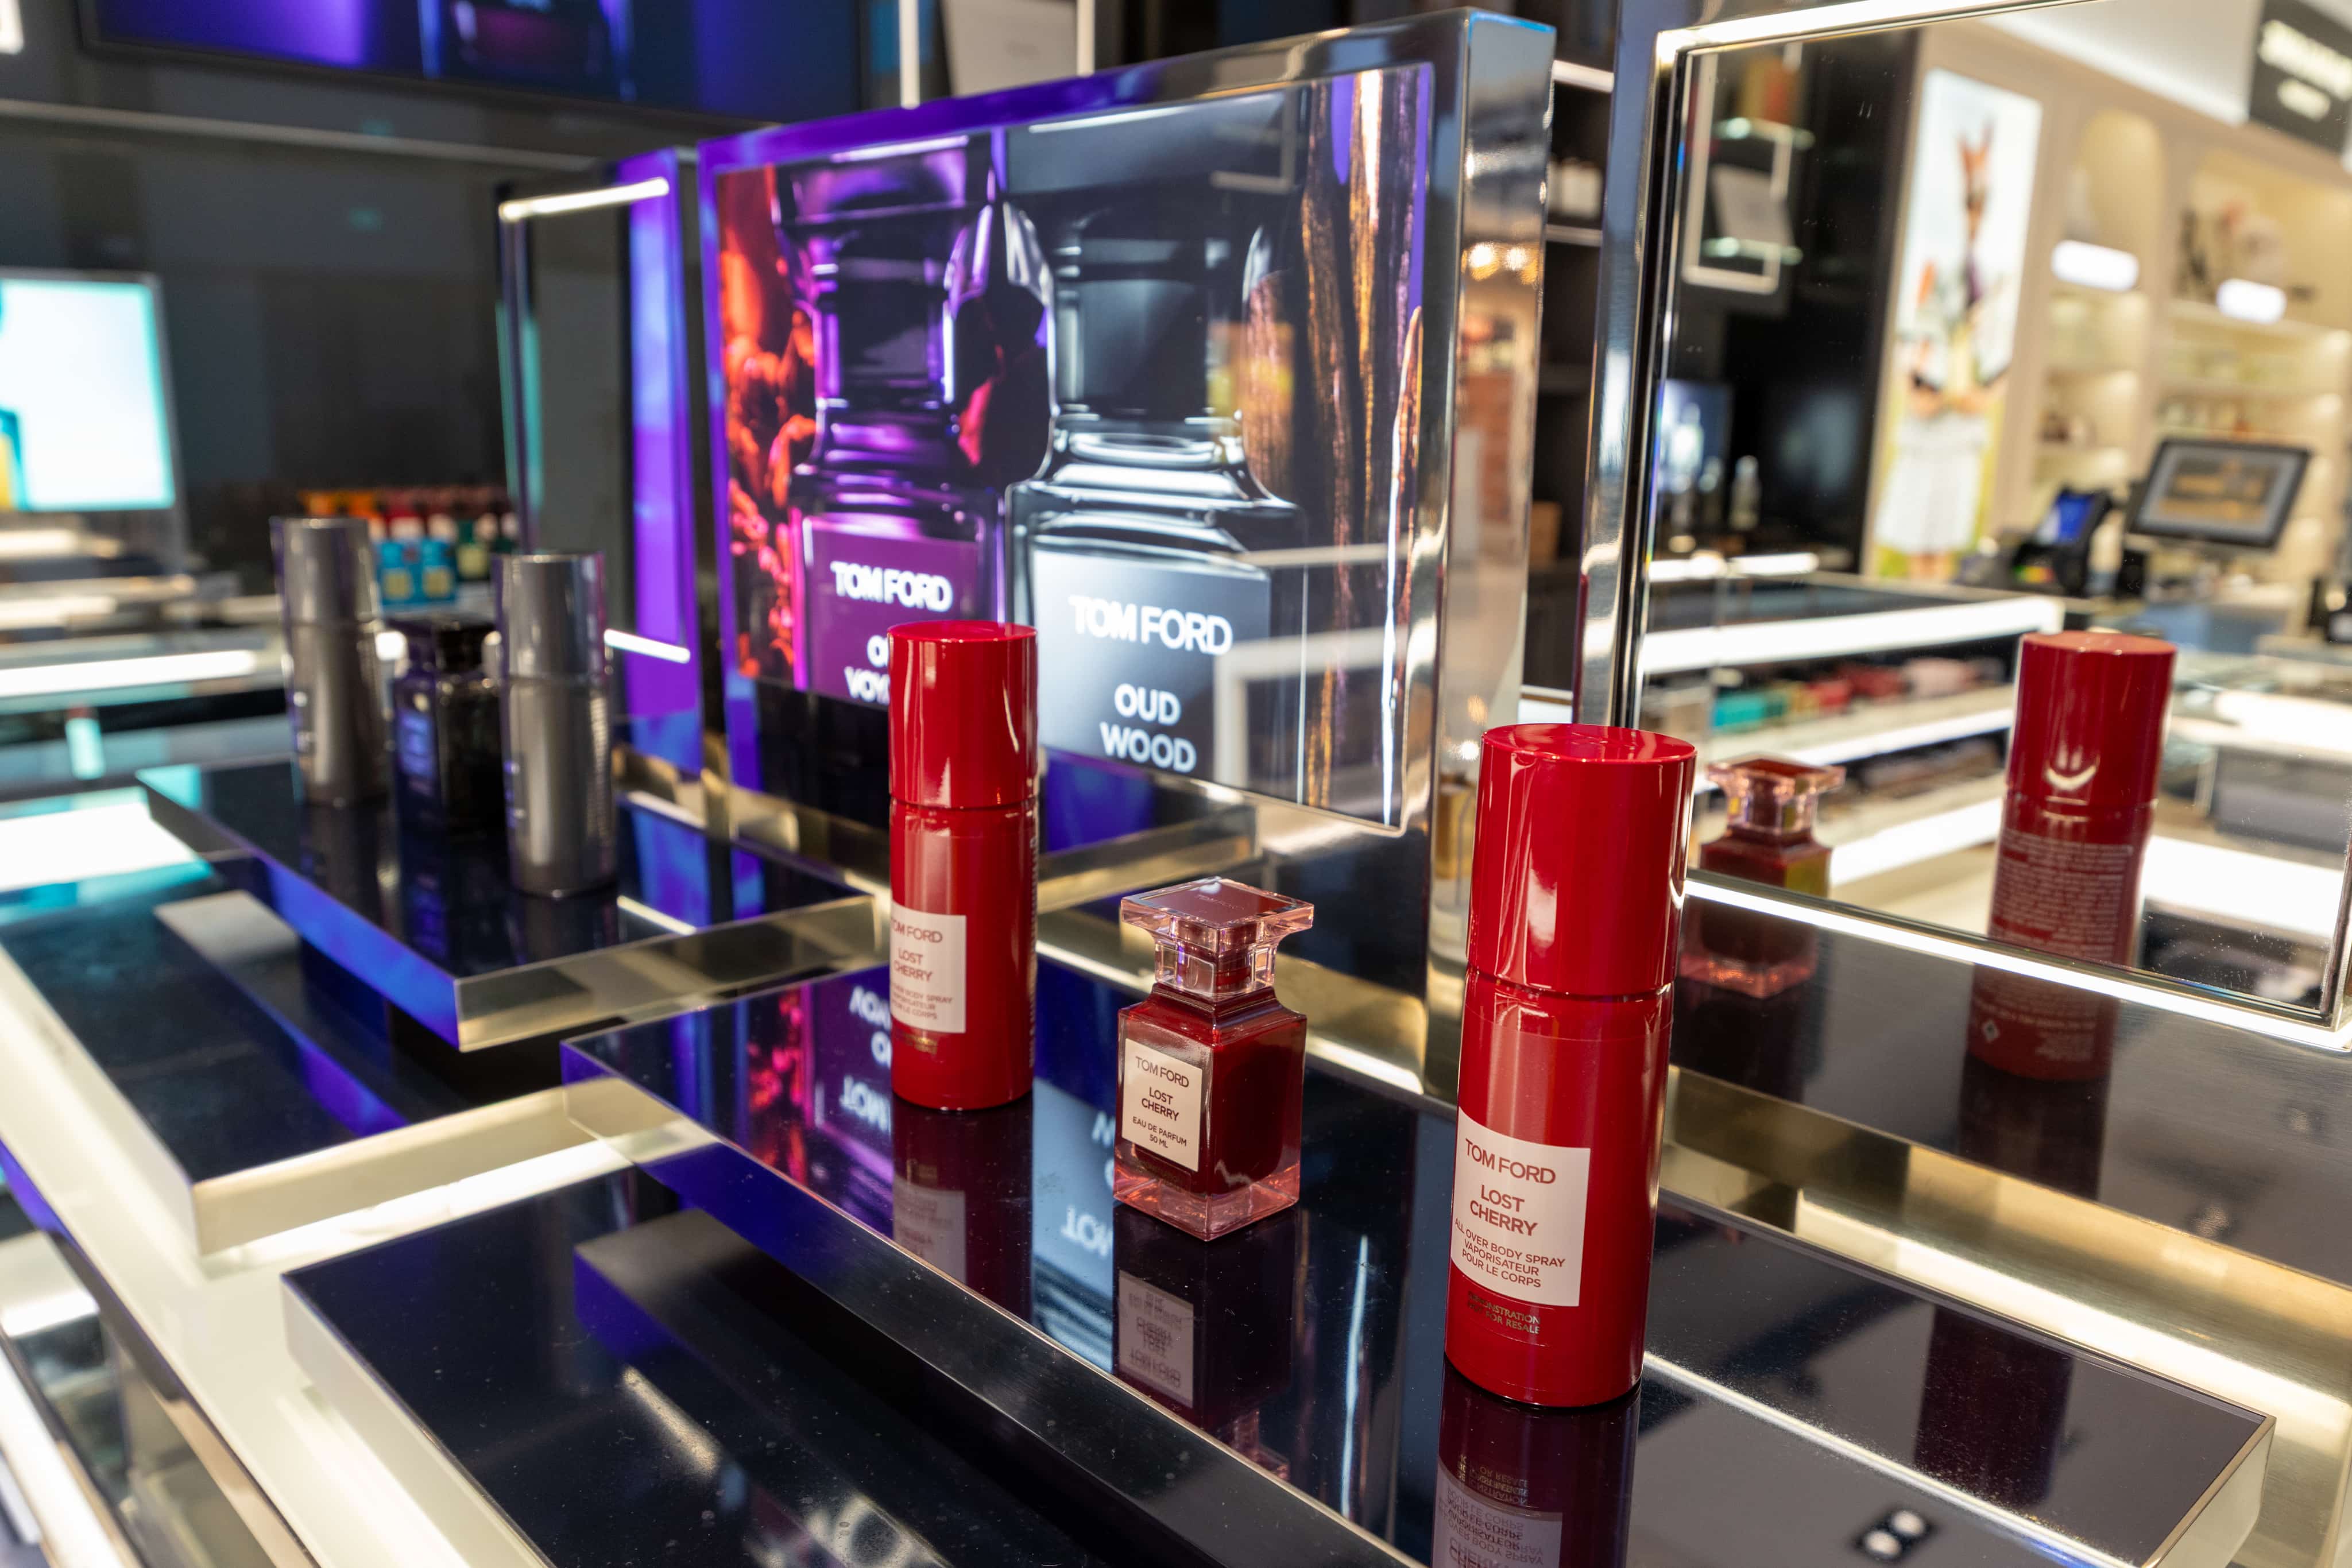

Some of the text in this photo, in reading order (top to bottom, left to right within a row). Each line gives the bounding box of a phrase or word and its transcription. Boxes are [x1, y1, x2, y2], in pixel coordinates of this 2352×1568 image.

[830, 560, 954, 612] TOM FORD
[1069, 595, 1233, 655] TOM FORD
[1114, 683, 1181, 726] OUD
[1100, 722, 1197, 773] WOOD
[907, 925, 943, 943] FORD
[894, 959, 933, 981] CHERRY
[898, 947, 923, 965] LOST
[1135, 1056, 1189, 1087] TOM FORD
[1141, 1098, 1179, 1121] CHERRY
[1149, 1086, 1174, 1105] LOST
[1132, 1116, 1187, 1147] EAU DE PARFUM
[1149, 1135, 1168, 1148] 50 ML
[1465, 1138, 1556, 1184] TOM FORD
[1480, 1184, 1525, 1212] LOST
[1470, 1200, 1538, 1236] CHERRY
[1455, 1218, 1565, 1268] ALL OVER BODY SPRAY
[1464, 1238, 1539, 1276] VAPORISATEUR
[1462, 1252, 1541, 1288] POUR LE CORPS
[1486, 1311, 1503, 1325] FOR
[1506, 1319, 1540, 1334] RESALE
